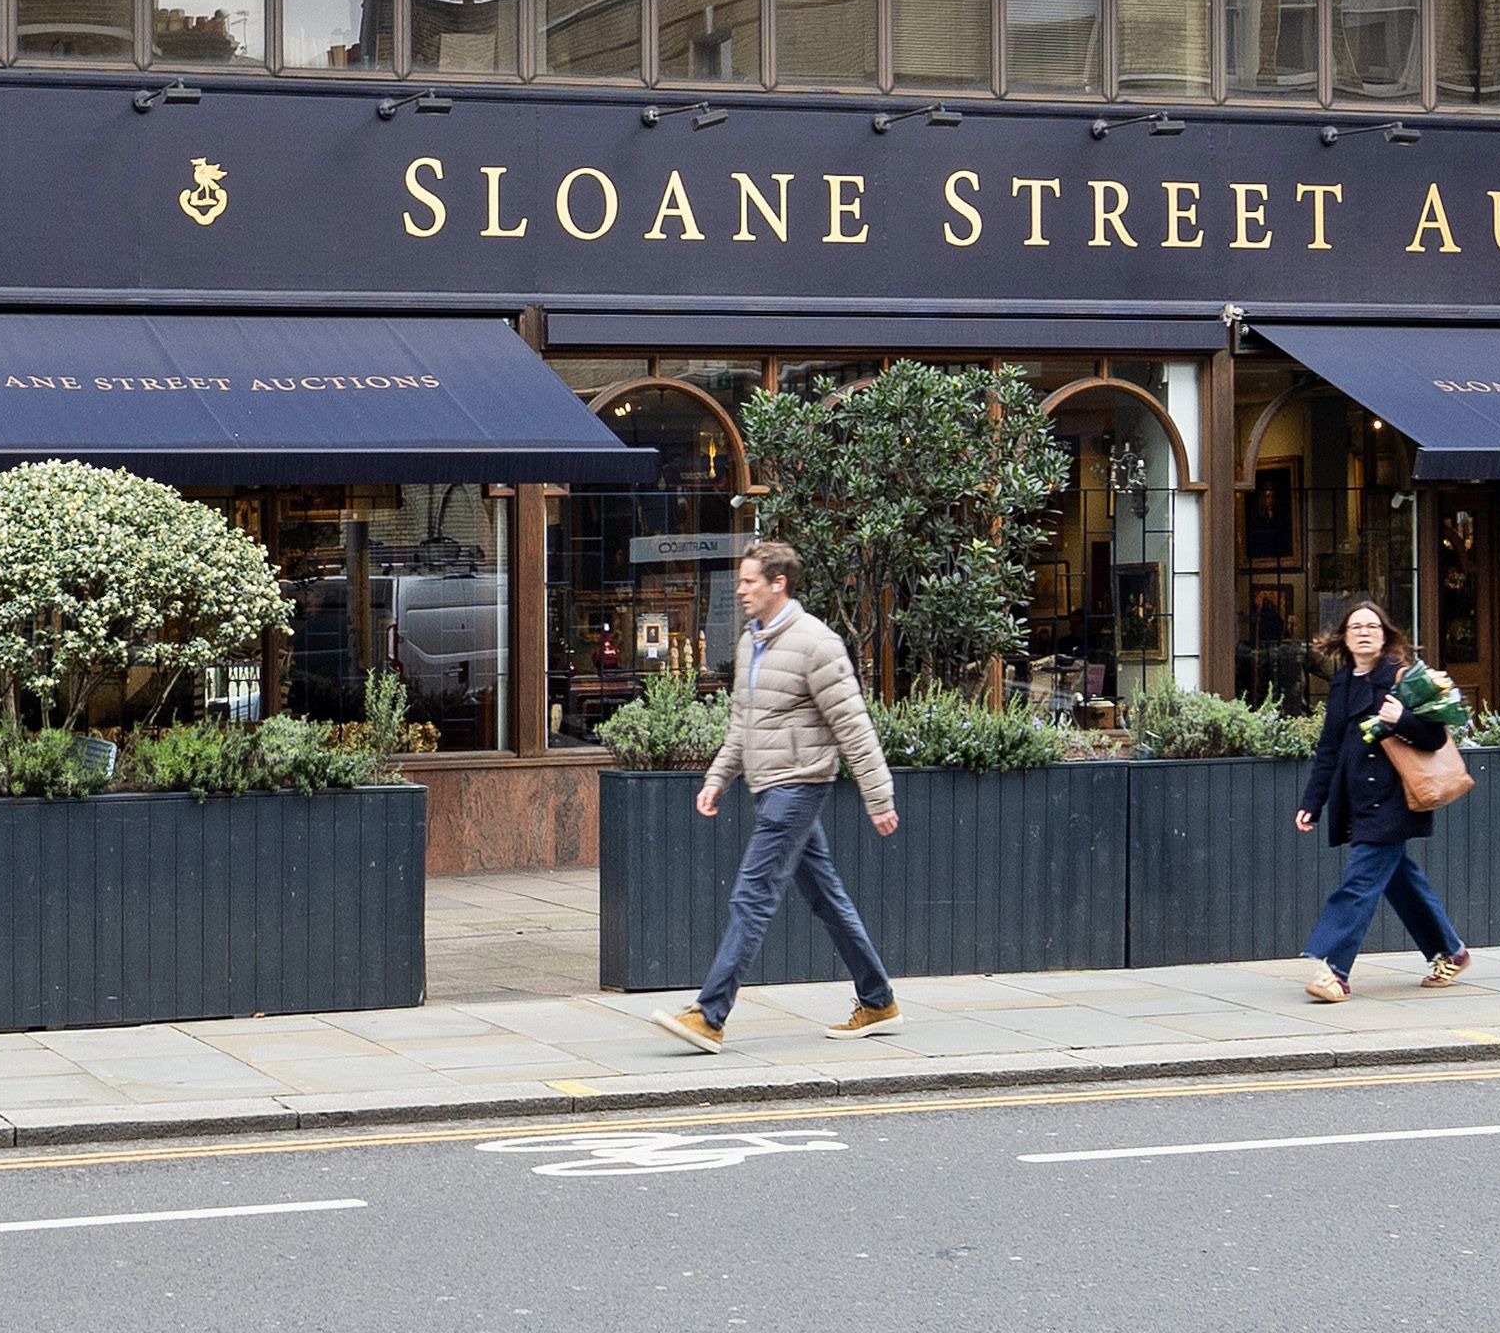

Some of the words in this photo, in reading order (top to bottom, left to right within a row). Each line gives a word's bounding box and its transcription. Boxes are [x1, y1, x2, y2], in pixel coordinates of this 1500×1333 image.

[402, 156, 870, 245] SLOANE
[942, 169, 1345, 252] STREET
[94, 376, 231, 391] STREET
[250, 375, 441, 391] AUCTIONS
